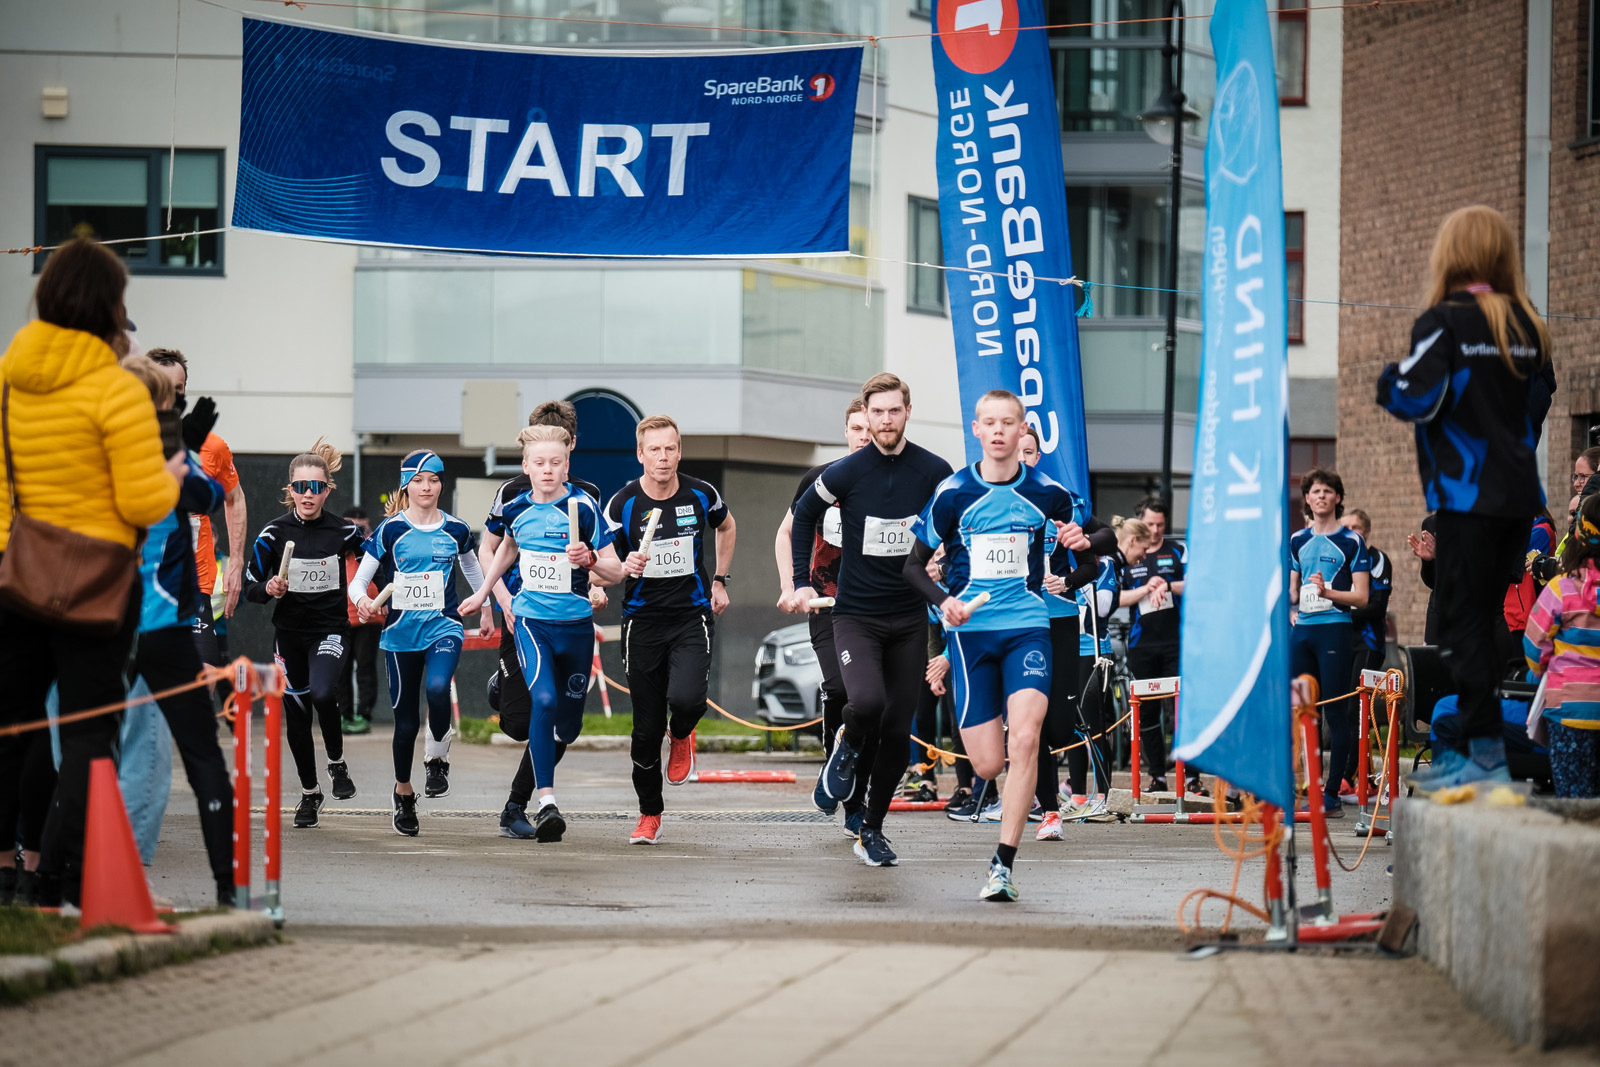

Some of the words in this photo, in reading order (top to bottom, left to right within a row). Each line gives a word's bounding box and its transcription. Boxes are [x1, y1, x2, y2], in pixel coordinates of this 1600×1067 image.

[703, 75, 805, 99] SpareBank
[731, 94, 804, 106] NORD-NORGE
[380, 109, 710, 197] START
[677, 506, 693, 516] DNB
[878, 531, 906, 545] 101
[655, 552, 681, 566] 106
[986, 549, 1016, 564] 401
[300, 570, 326, 582] 702
[529, 564, 556, 580] 602
[404, 586, 430, 599] 701
